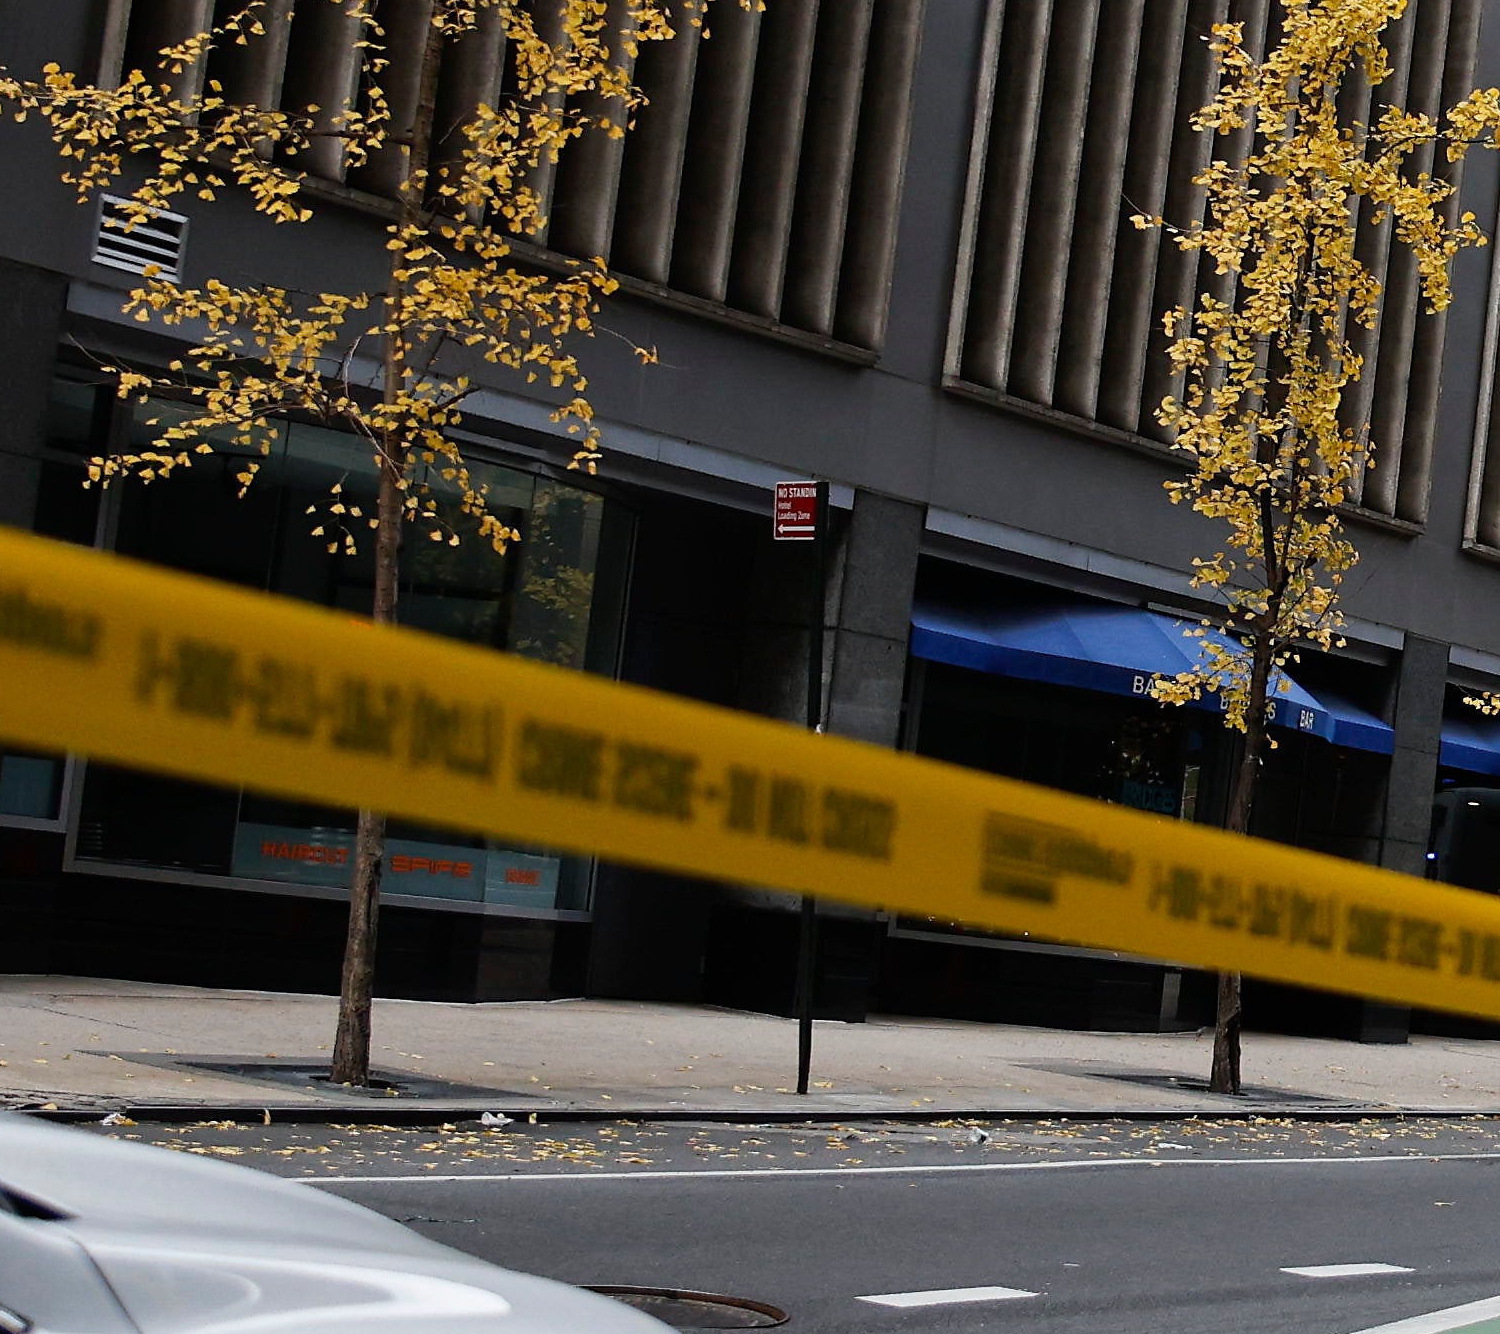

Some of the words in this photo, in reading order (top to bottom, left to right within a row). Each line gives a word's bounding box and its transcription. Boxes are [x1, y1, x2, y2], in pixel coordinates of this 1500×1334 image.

[778, 488, 788, 498] NO
[789, 488, 816, 498] STANDIN
[778, 511, 797, 522] Loading
[1132, 675, 1156, 695] BA
[1300, 710, 1314, 730] BAR
[261, 841, 350, 864] HAIRCUT
